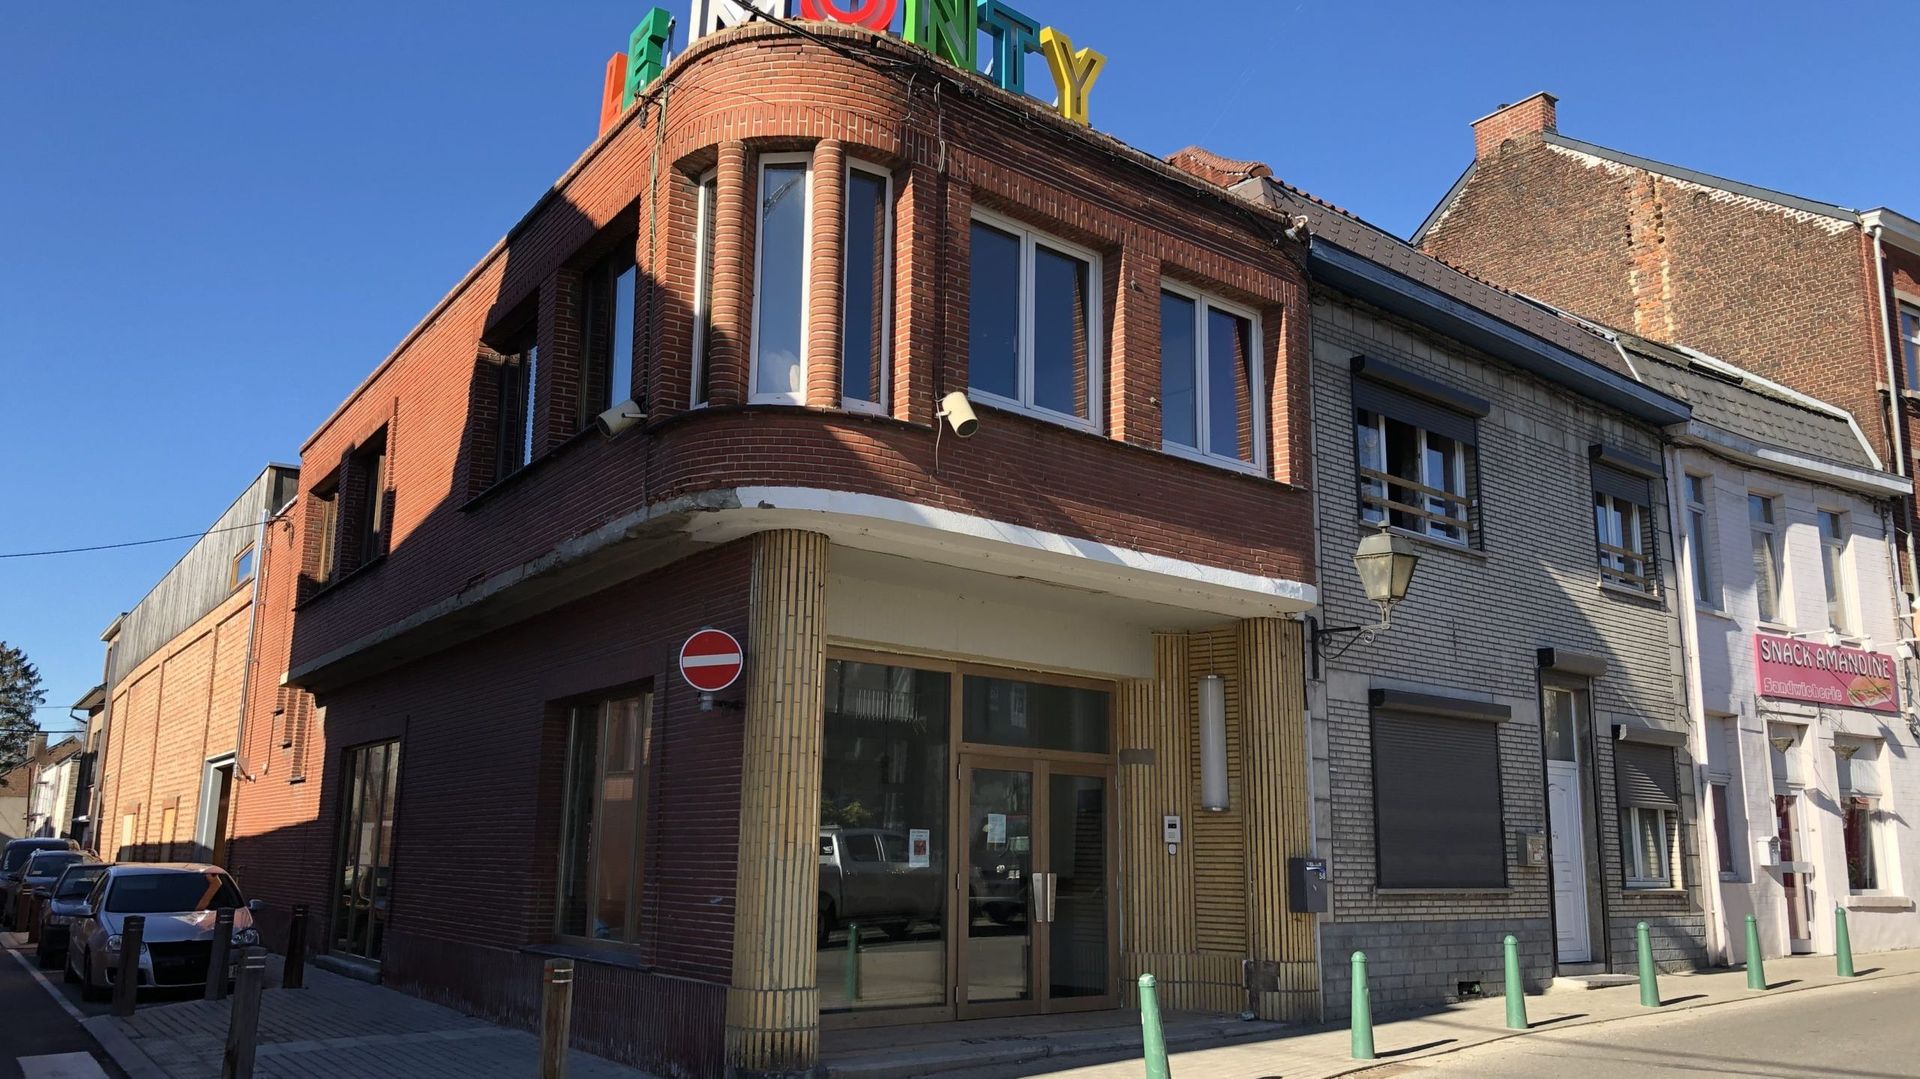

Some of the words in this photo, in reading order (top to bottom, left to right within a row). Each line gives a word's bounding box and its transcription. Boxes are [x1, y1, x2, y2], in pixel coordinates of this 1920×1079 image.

[598, 7, 671, 136] LE
[1761, 638, 1812, 668] SNACK
[1816, 647, 1891, 679] AMANDINE
[1763, 677, 1842, 701] Sandwicherie
